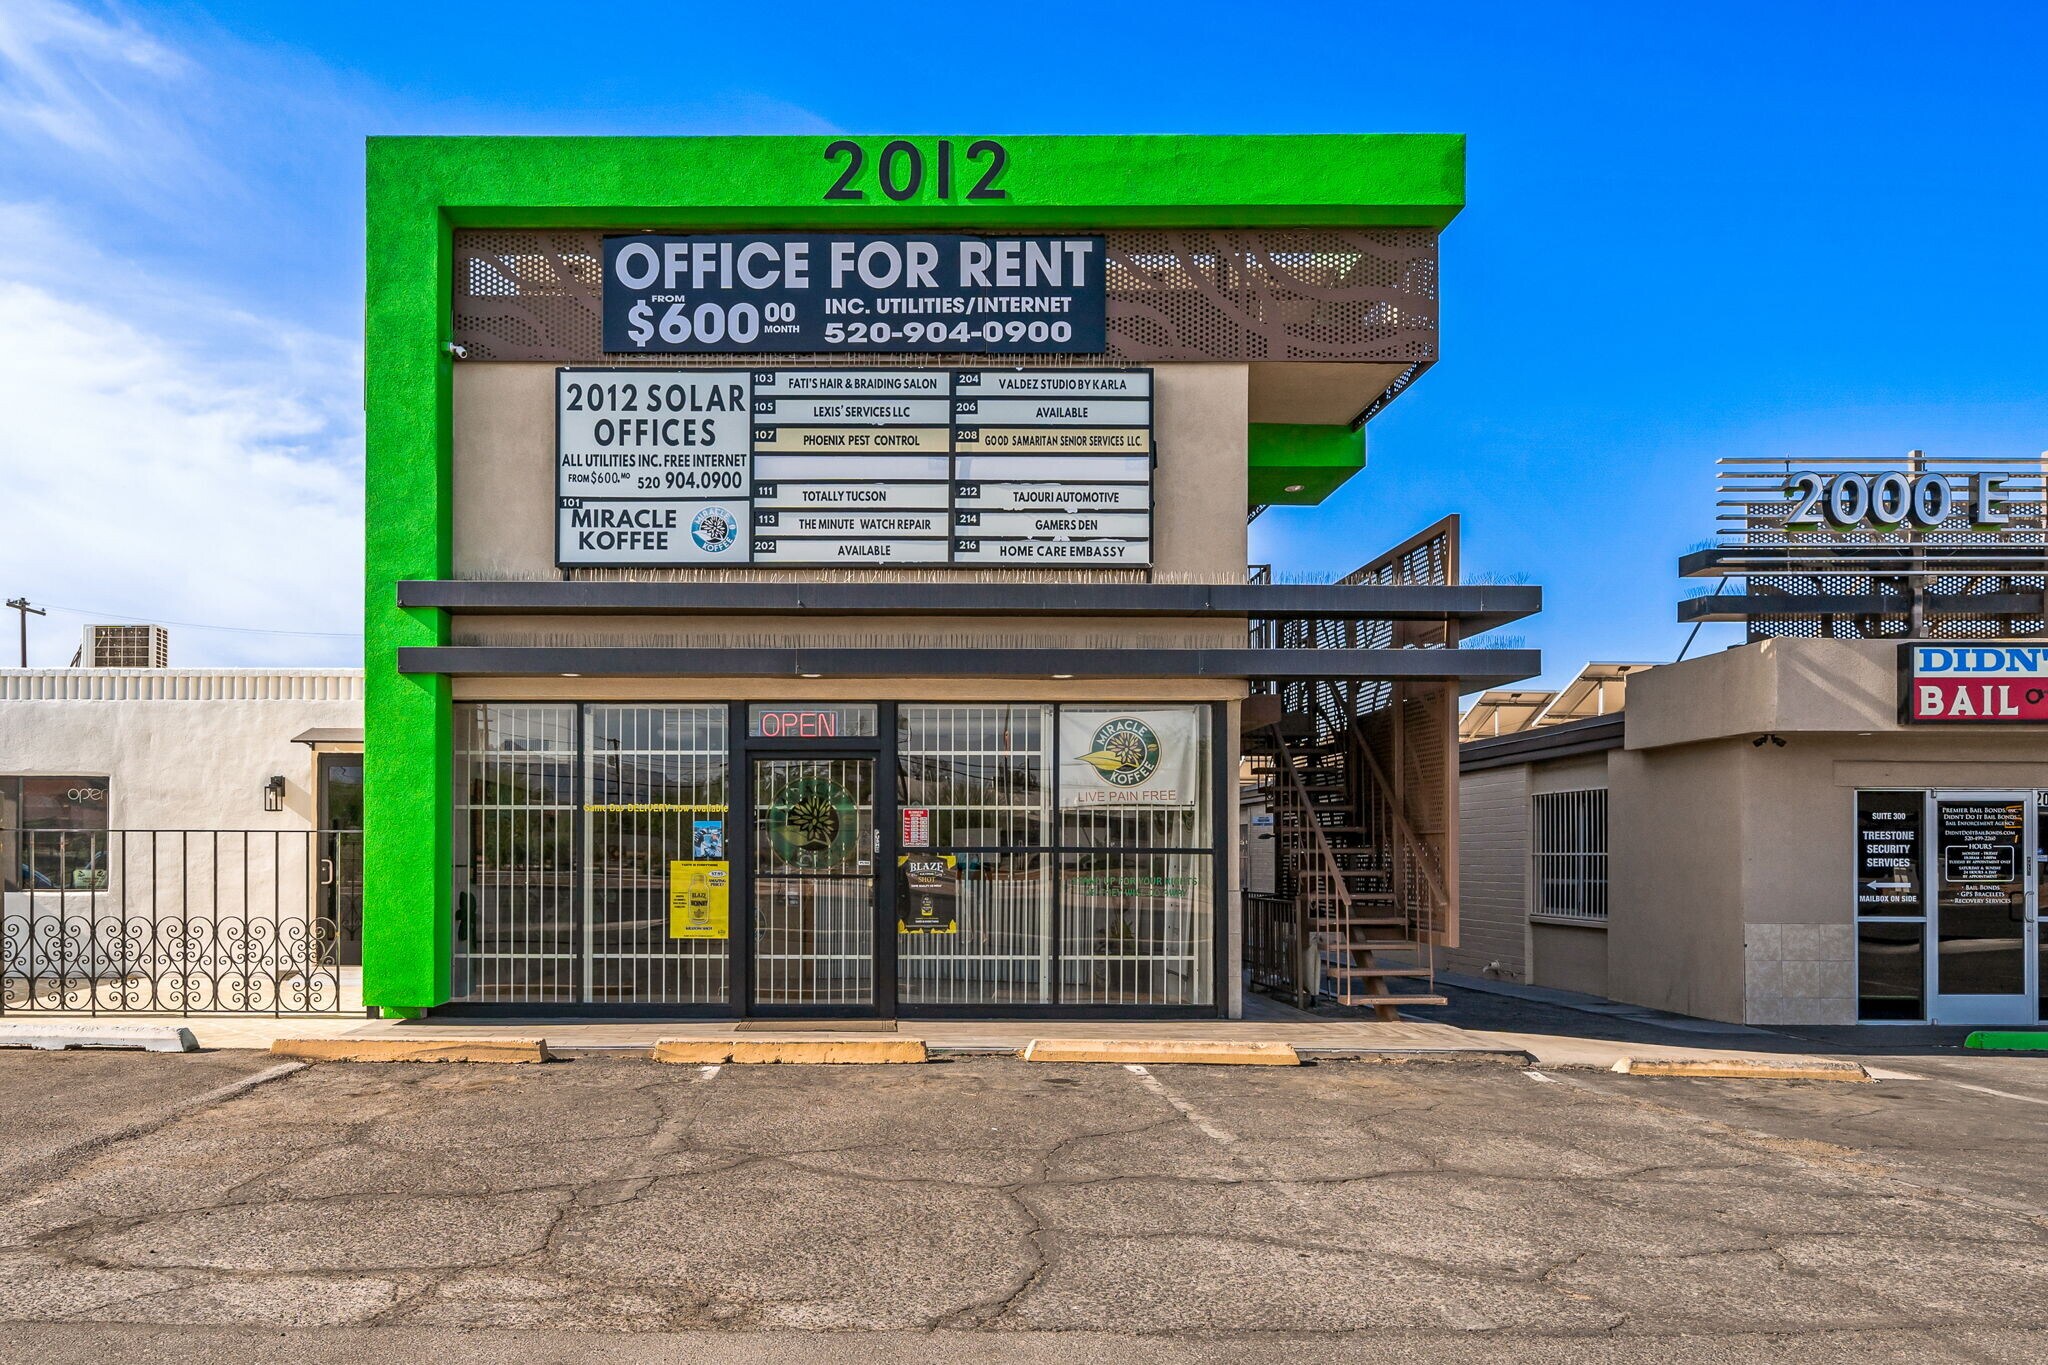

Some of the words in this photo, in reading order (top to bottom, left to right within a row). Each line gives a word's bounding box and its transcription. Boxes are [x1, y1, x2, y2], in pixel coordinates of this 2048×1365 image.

[823, 140, 1006, 201] 2012
[615, 242, 809, 289] OFFICE
[831, 241, 939, 288] FOR
[960, 241, 1093, 287] RENT
[651, 295, 685, 303] FROM
[825, 298, 870, 314] INC.
[876, 297, 1072, 315] UTILITIES/INTERNET
[628, 300, 760, 347] $600
[764, 325, 800, 333] MONTH
[824, 321, 1072, 343] 520-904-0900
[754, 374, 773, 383] 103
[788, 378, 818, 389] FATI'S
[819, 378, 843, 389] HAIR
[845, 378, 853, 389] &
[854, 378, 902, 389] BRAIDING
[903, 378, 937, 389] SALON
[959, 375, 979, 383] 204
[999, 379, 1039, 390] VALDEZ
[1040, 379, 1076, 390] STUDIO
[1078, 379, 1091, 390] BY
[1092, 379, 1127, 390] KARLA
[566, 383, 638, 411] 2012
[646, 384, 746, 412] SOLAR
[754, 403, 773, 411] 105
[813, 405, 844, 418] LEXIS'
[845, 407, 891, 418] SERVICES
[893, 407, 910, 418] LLC
[956, 403, 976, 411] 206
[1036, 407, 1088, 418] AVAILABLE
[594, 418, 716, 446] OFFICES
[755, 430, 774, 439] 107
[957, 431, 978, 440] 208
[803, 435, 846, 446] PHOENIX
[848, 435, 870, 446] PEST
[874, 435, 920, 446] CONTROL
[985, 435, 1009, 446] GOOD
[1012, 435, 1058, 446] SAMARITAN
[1059, 435, 1087, 446] SENIOR
[1089, 435, 1124, 446] SERVICES
[1127, 435, 1142, 446] LLC.
[562, 454, 582, 467] ALL
[585, 454, 636, 467] UTILITIES
[638, 454, 662, 467] INC.
[664, 454, 690, 467] FREE
[693, 454, 747, 467] INTERNET
[568, 473, 590, 483] FROM
[637, 476, 660, 489] 520
[665, 471, 742, 489] 904.0900
[758, 487, 773, 495] 111
[802, 491, 847, 501] TOTALLY
[846, 491, 887, 501] TUCSON
[959, 488, 977, 496] 212
[1013, 491, 1054, 502] TAJOURI
[1055, 492, 1119, 502] AUTOMOTIVE
[562, 499, 580, 507] 101
[1782, 471, 1951, 526] 2000
[1974, 472, 2009, 524] E
[571, 509, 677, 528] MIRACLE
[692, 507, 731, 524] MIRACLE
[758, 515, 775, 524] 113
[959, 515, 977, 523] 214
[799, 519, 817, 529] THE
[818, 519, 855, 530] MINUTE
[860, 519, 896, 530] WATCH
[897, 519, 931, 530] REPAIR
[1035, 520, 1077, 530] GAMERS
[1078, 520, 1098, 530] DEN
[579, 531, 668, 550] KOFFEE
[702, 536, 733, 551] KOFFEE
[754, 542, 775, 550] 202
[959, 541, 977, 549] 216
[837, 545, 891, 556] AVAILABLE
[1000, 546, 1033, 557] HOME
[1037, 546, 1067, 557] CARE
[1070, 546, 1125, 557] EMBASSY
[1919, 685, 2019, 716] BAIL
[762, 713, 835, 737] OPEN
[1096, 720, 1148, 745] MIRACLE
[1110, 761, 1155, 784] KOFFEE
[1078, 792, 1105, 802] LIVE
[1109, 791, 1138, 801] PAIN
[1142, 790, 1176, 801] FREE
[583, 803, 606, 812] Same
[609, 803, 624, 813] Day
[627, 803, 670, 813] DELIVERY
[673, 804, 689, 813] now
[692, 803, 729, 813] available
[1872, 812, 1892, 820] SUITE
[1893, 812, 1906, 820] 300
[1862, 831, 1915, 840] TREESTONE
[1866, 844, 1911, 854] SECURITY
[910, 862, 944, 873] BLAZE
[1866, 858, 1910, 867] SERVICES
